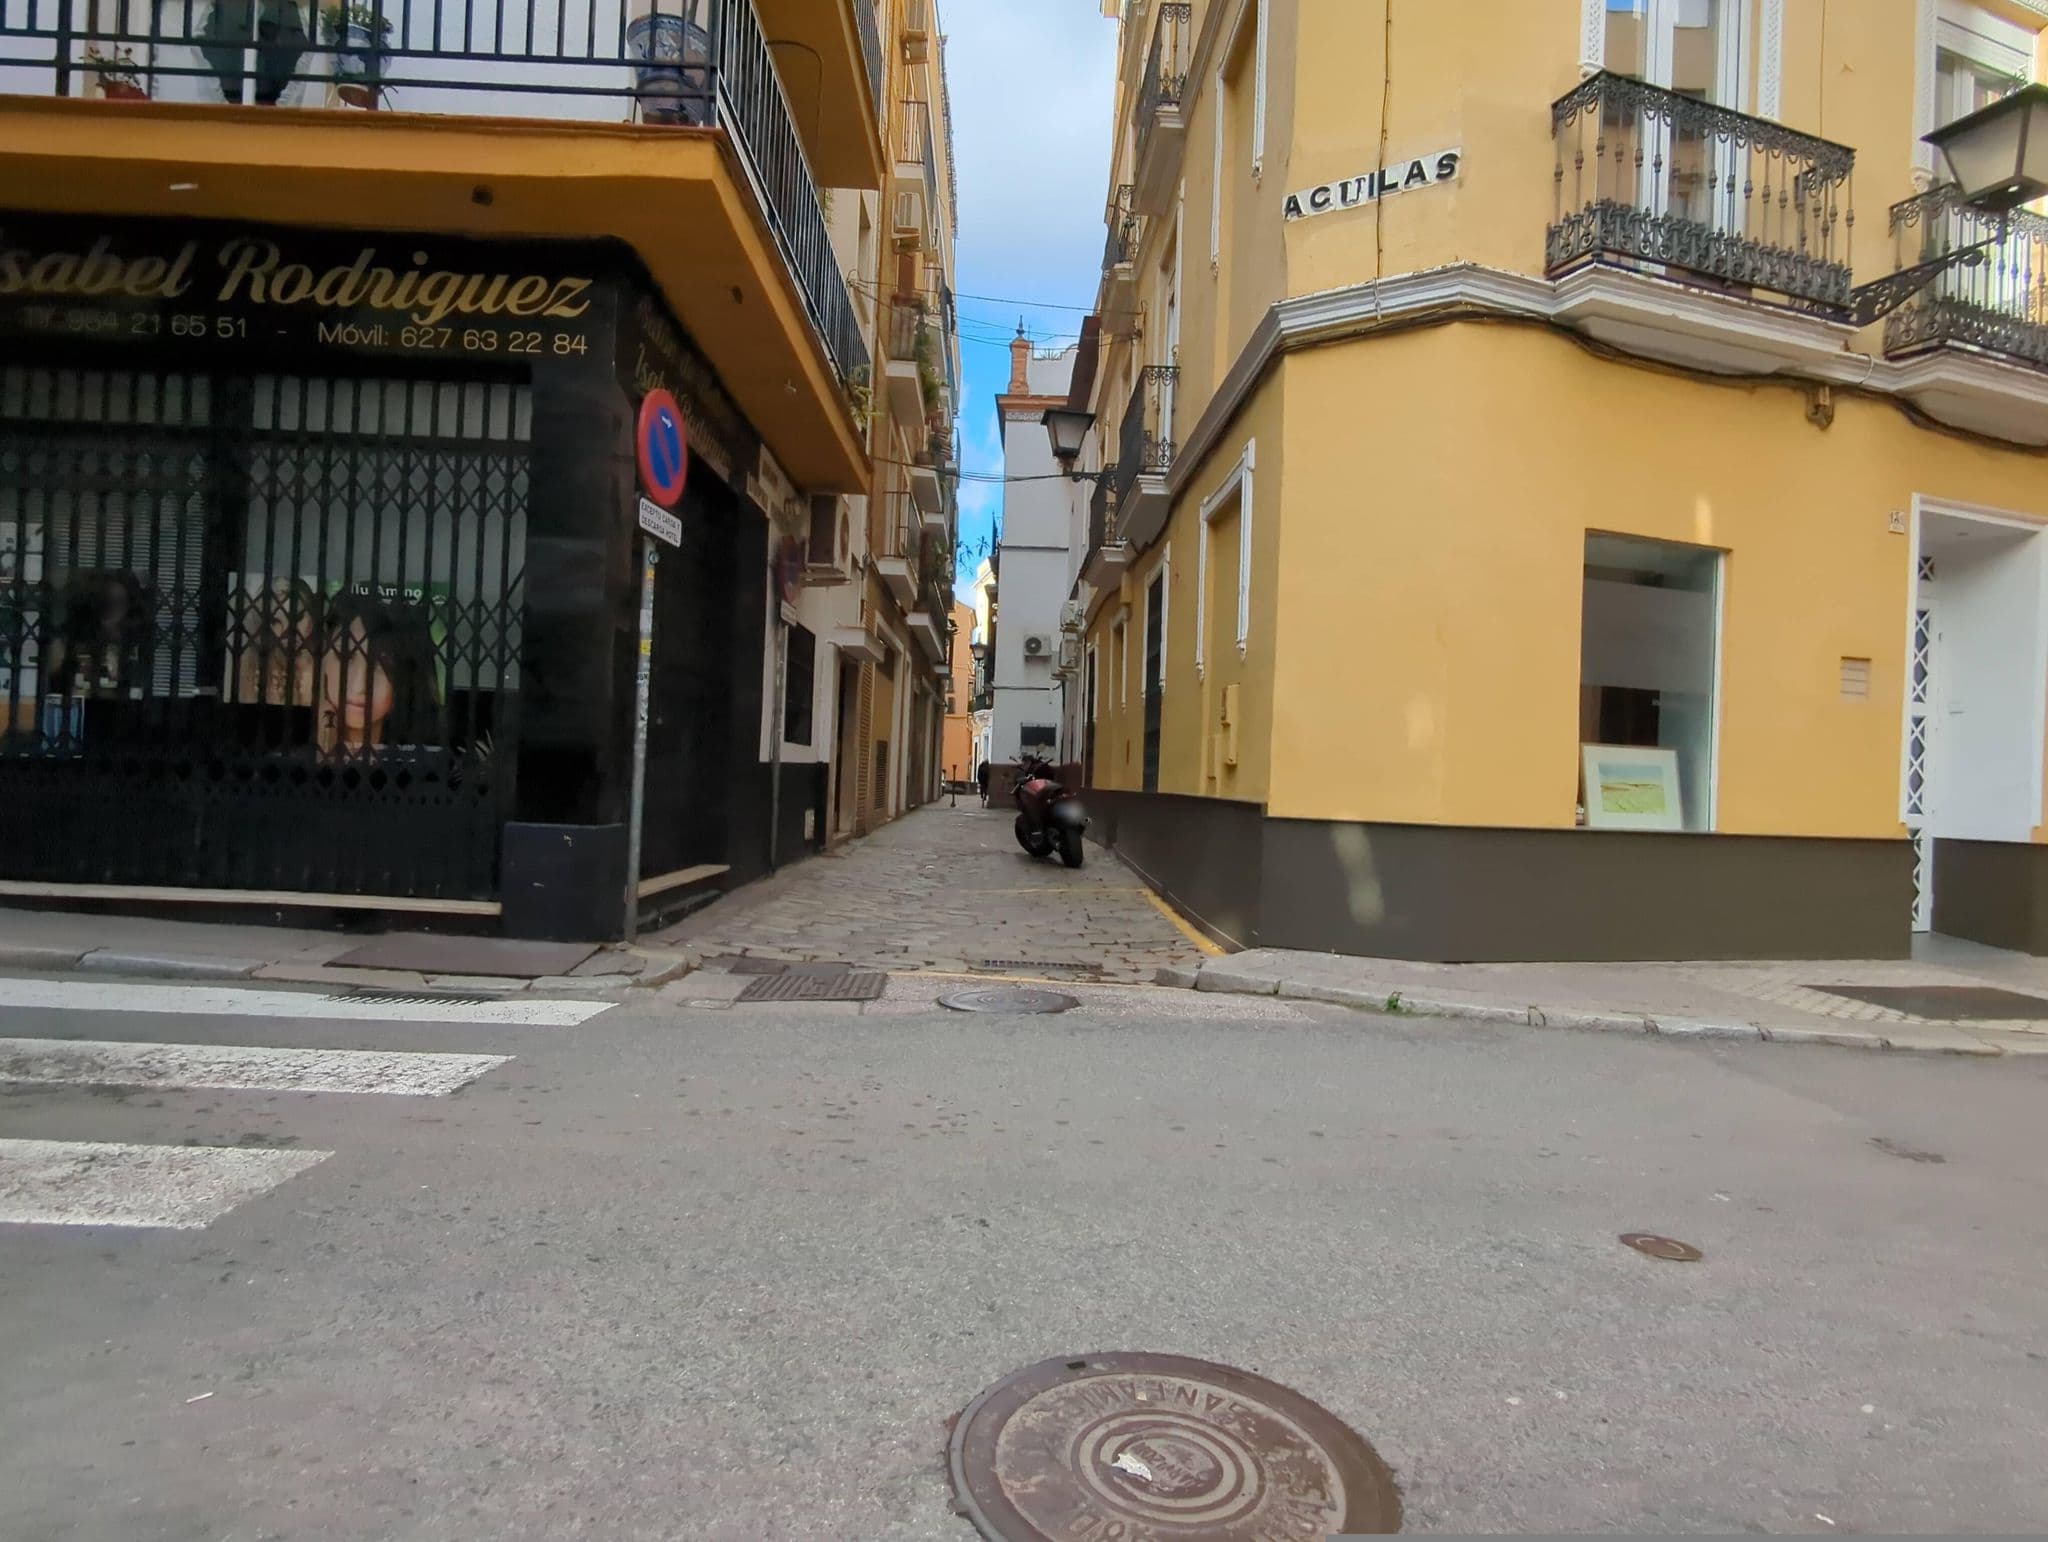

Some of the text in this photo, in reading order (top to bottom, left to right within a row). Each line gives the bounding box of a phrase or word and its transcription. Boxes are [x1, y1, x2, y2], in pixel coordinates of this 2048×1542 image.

[0, 230, 199, 297] sabel
[216, 236, 594, 326] Rodriguez
[130, 311, 161, 335] 21
[171, 314, 207, 338] 65
[216, 316, 247, 339] 51
[317, 319, 389, 347] Móvil:
[400, 326, 451, 349] 627
[463, 329, 498, 352] 63
[508, 330, 542, 353] 22
[552, 333, 588, 356] 84
[641, 514, 665, 534] DESCARGA
